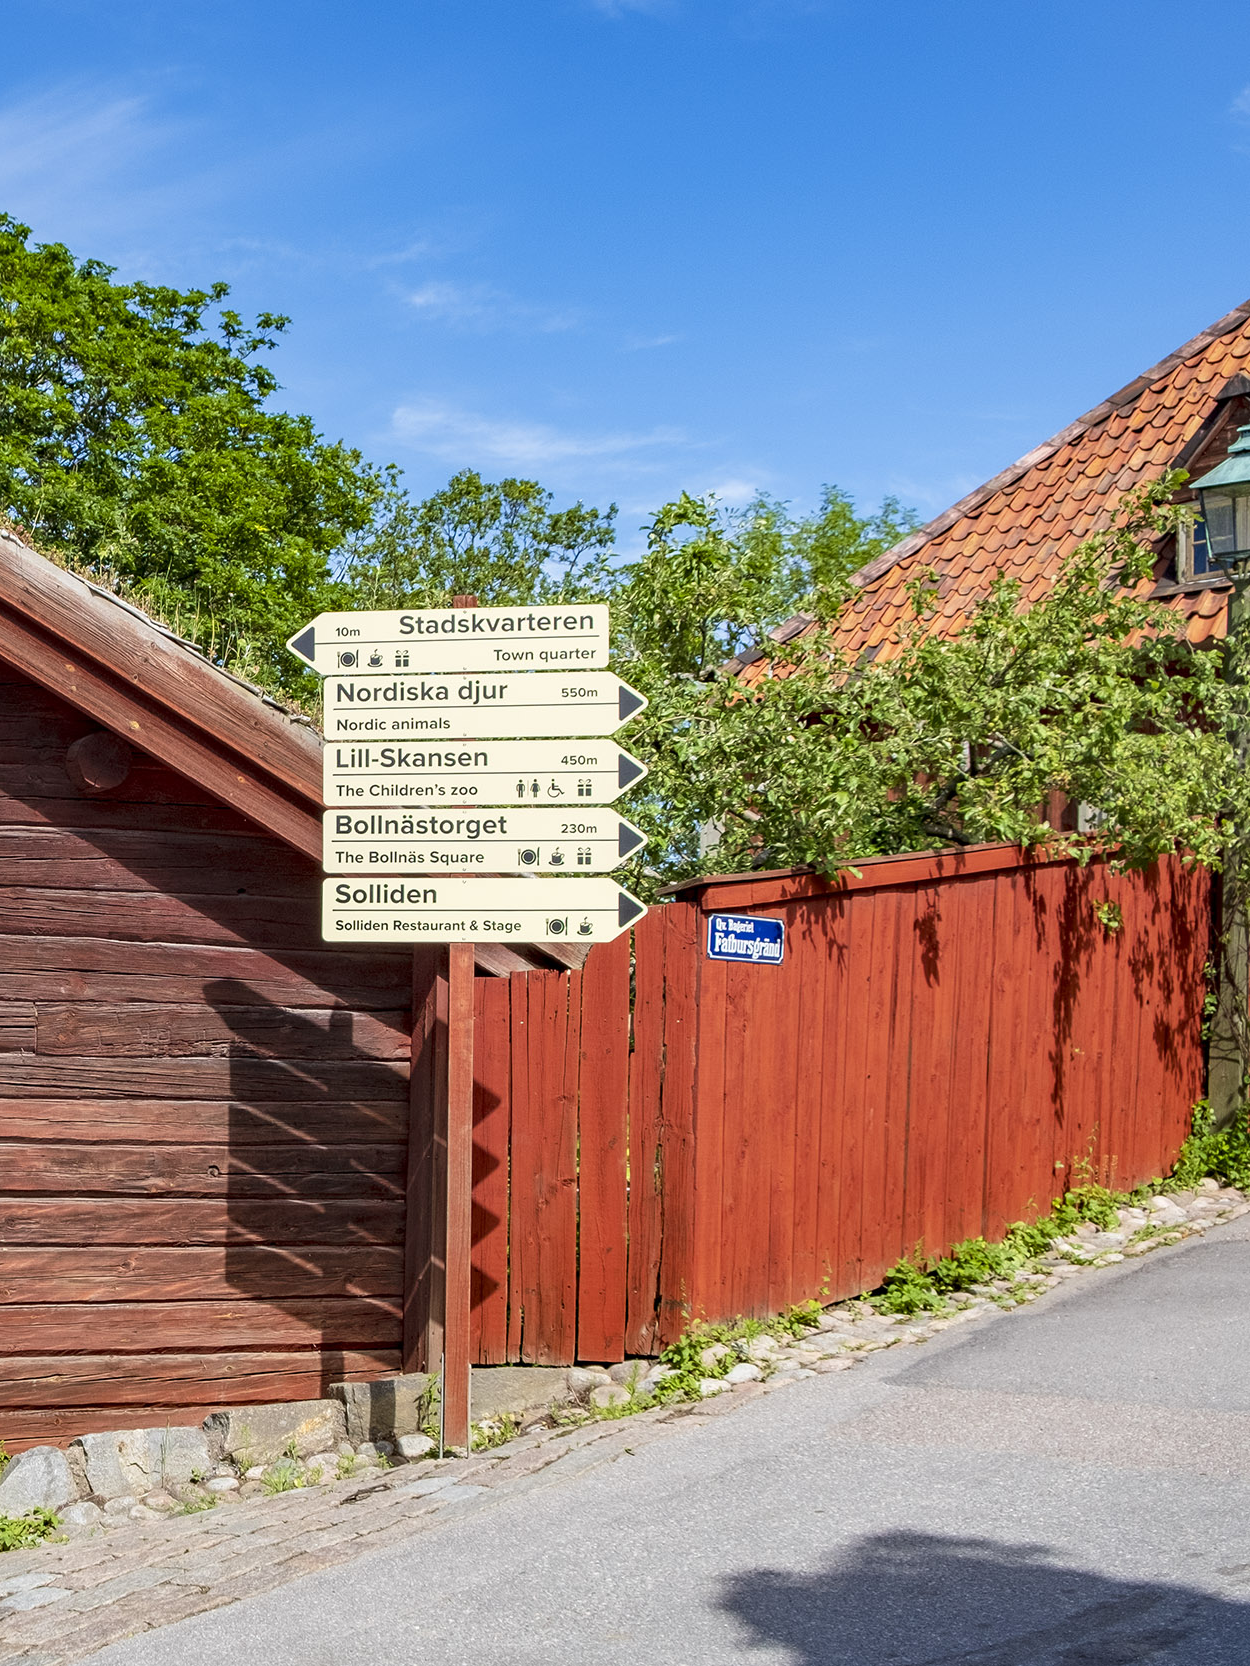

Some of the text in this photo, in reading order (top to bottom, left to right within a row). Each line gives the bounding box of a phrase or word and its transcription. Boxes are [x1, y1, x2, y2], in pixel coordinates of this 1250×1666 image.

[335, 626, 361, 637] 10m
[399, 613, 594, 635] Stadskvarteren
[493, 648, 597, 663] Town quarter
[336, 680, 508, 705] Nordiska djur
[561, 687, 598, 698] 550m
[336, 717, 451, 731] Nordic animals
[336, 748, 488, 768] Lill-Skansen
[560, 755, 598, 766] 450m
[335, 783, 478, 797] The Children’s zoo
[335, 815, 507, 839] Bollnästorget
[561, 823, 597, 834] 230m
[335, 850, 485, 866] The Bollnäs Square
[335, 883, 437, 904] Solliden
[335, 919, 522, 934] Solliden Restaurant & Stage
